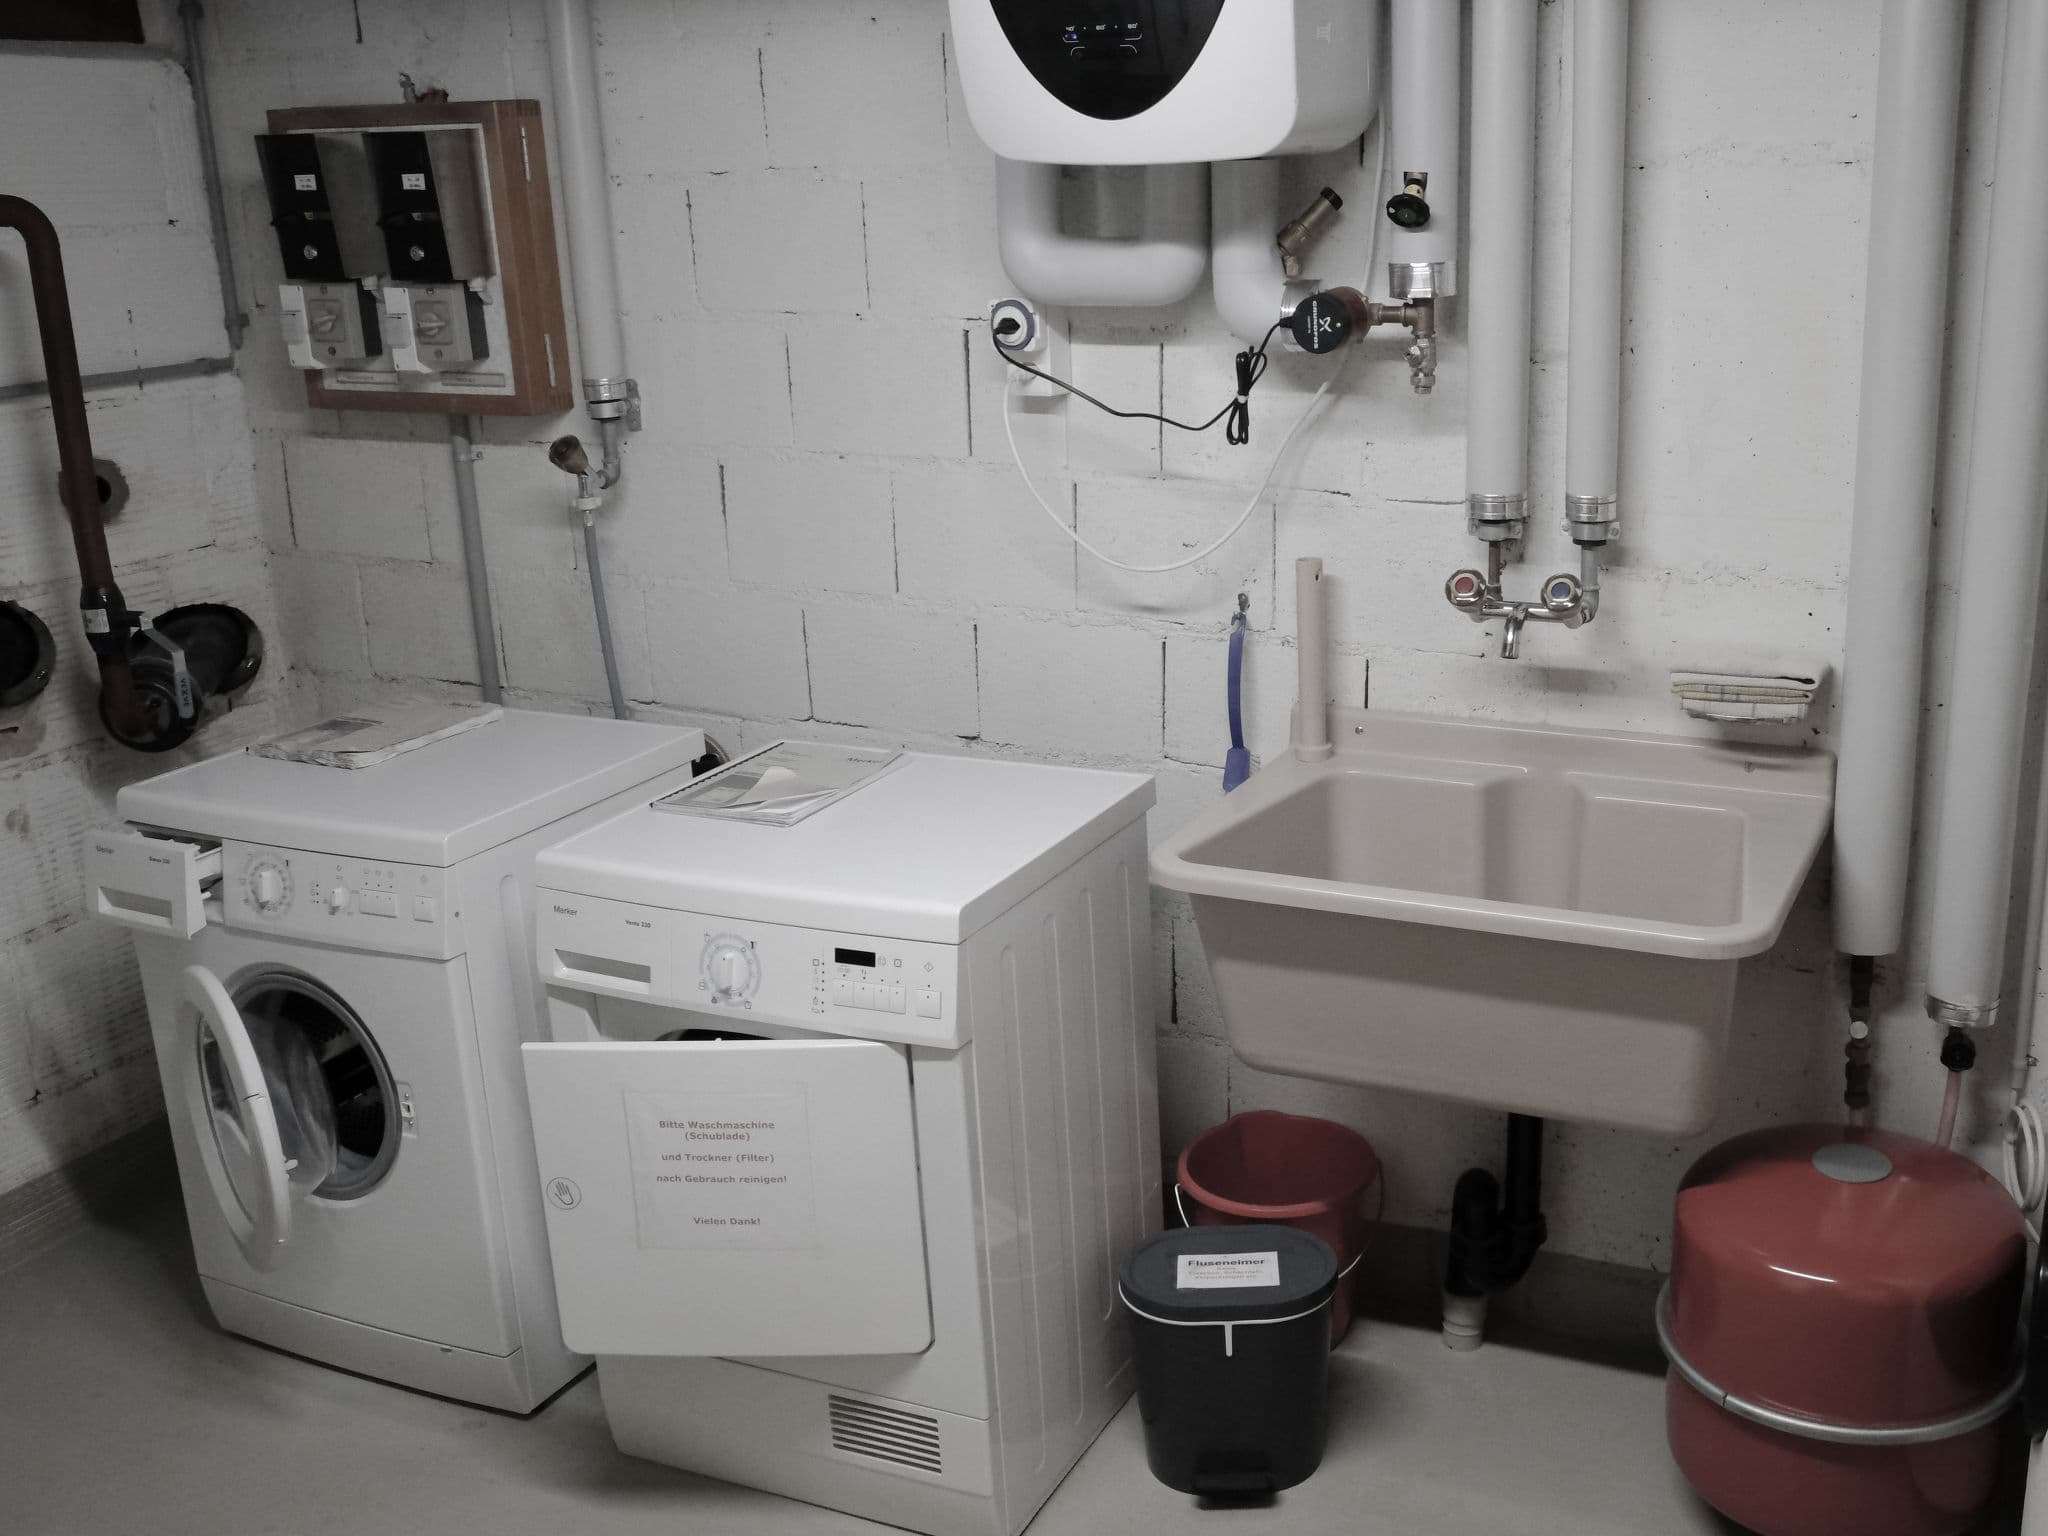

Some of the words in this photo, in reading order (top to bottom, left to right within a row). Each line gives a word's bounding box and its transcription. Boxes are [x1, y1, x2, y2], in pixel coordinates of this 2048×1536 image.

[659, 1120, 685, 1129] Bitte
[688, 1121, 775, 1130] Waschmaschine
[685, 1131, 750, 1141] (Schublade)
[661, 1153, 682, 1161] und
[685, 1153, 733, 1162] Trockner
[736, 1154, 774, 1163] (Filter)
[656, 1175, 682, 1183] nach
[685, 1175, 736, 1184] Gebrauch
[739, 1175, 787, 1185] reinigen!
[693, 1217, 726, 1225] Vielen
[729, 1217, 760, 1226] Dank!
[1188, 1259, 1265, 1267] Fluseneimer
